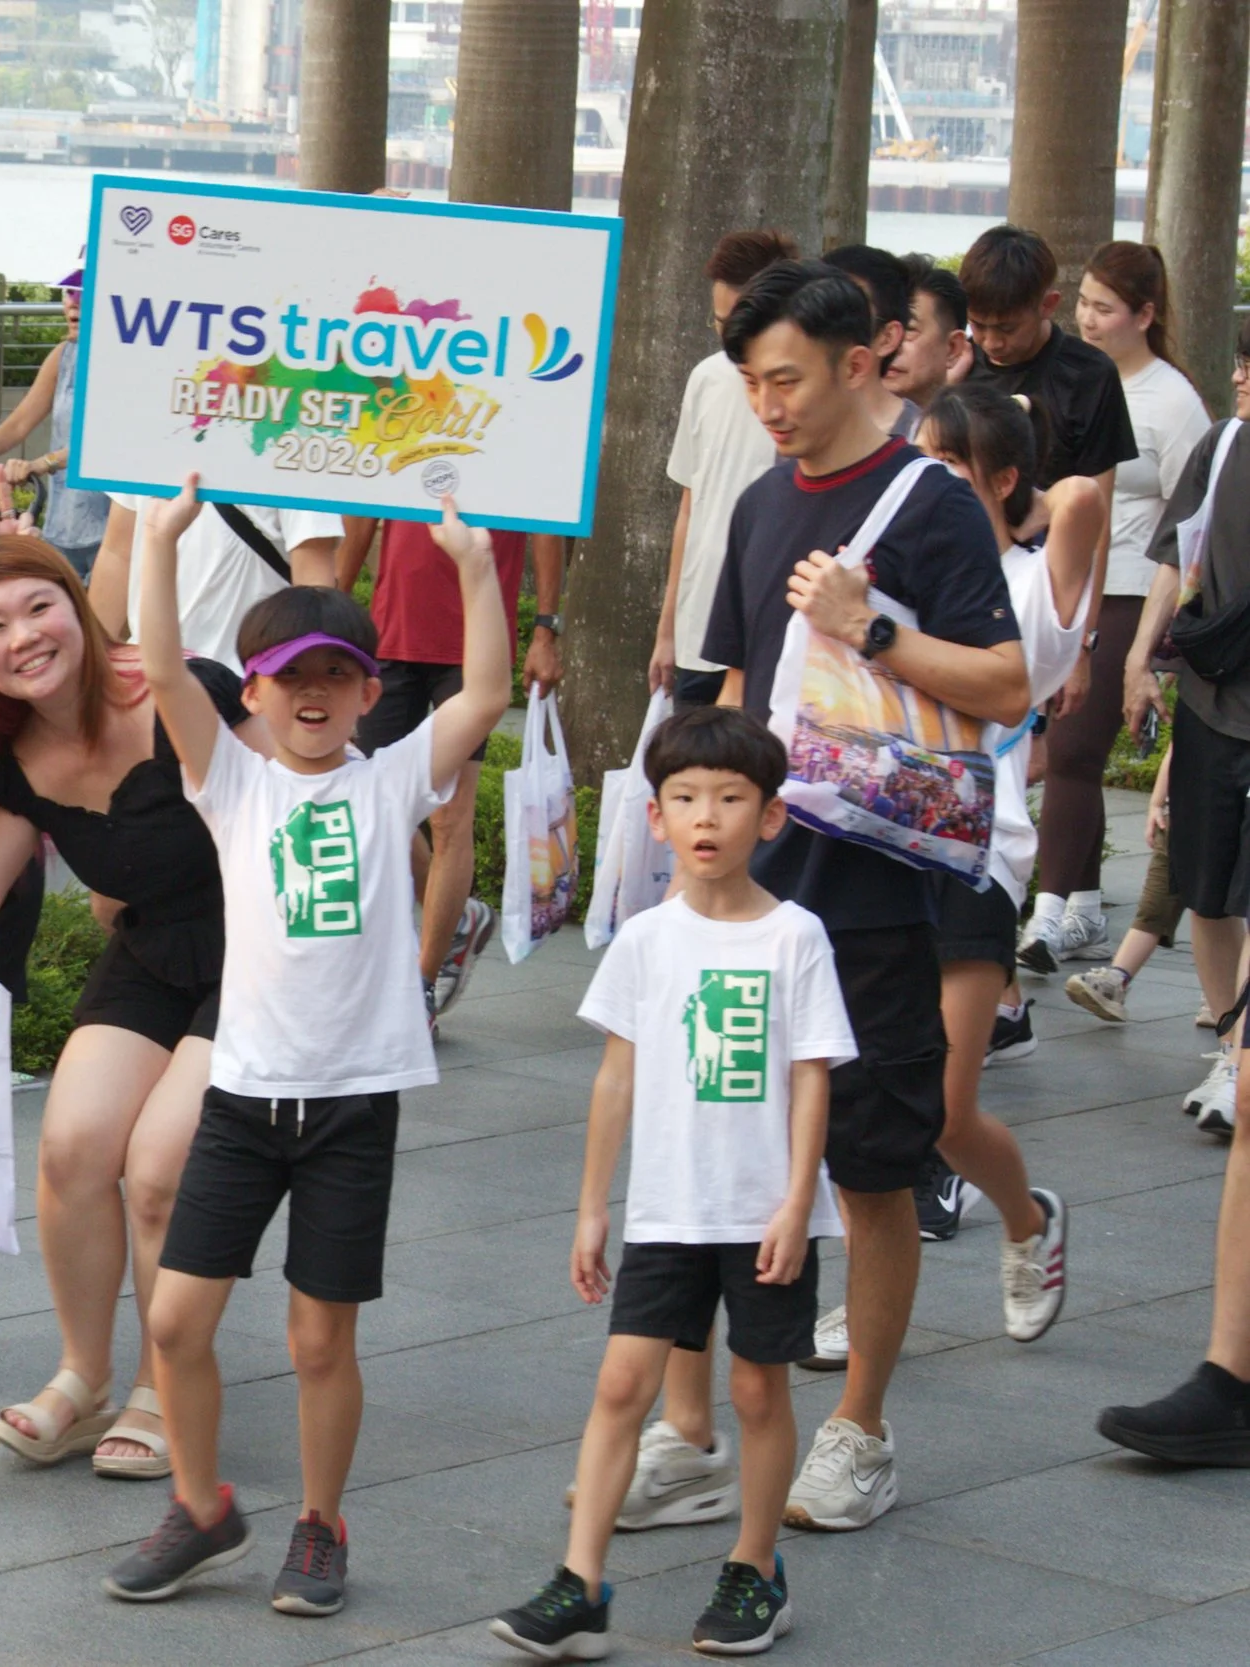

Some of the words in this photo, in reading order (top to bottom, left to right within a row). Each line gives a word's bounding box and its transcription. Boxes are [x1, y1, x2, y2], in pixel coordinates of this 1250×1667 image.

[171, 223, 193, 237] SG
[199, 226, 241, 242] Cares
[110, 294, 266, 356] WTS
[280, 304, 510, 377] travel
[171, 377, 293, 423] READY
[300, 389, 369, 430] SET
[375, 387, 502, 442] Gold!
[274, 433, 382, 477] 2026
[309, 806, 356, 932] POLO
[721, 974, 766, 1098] POLO
